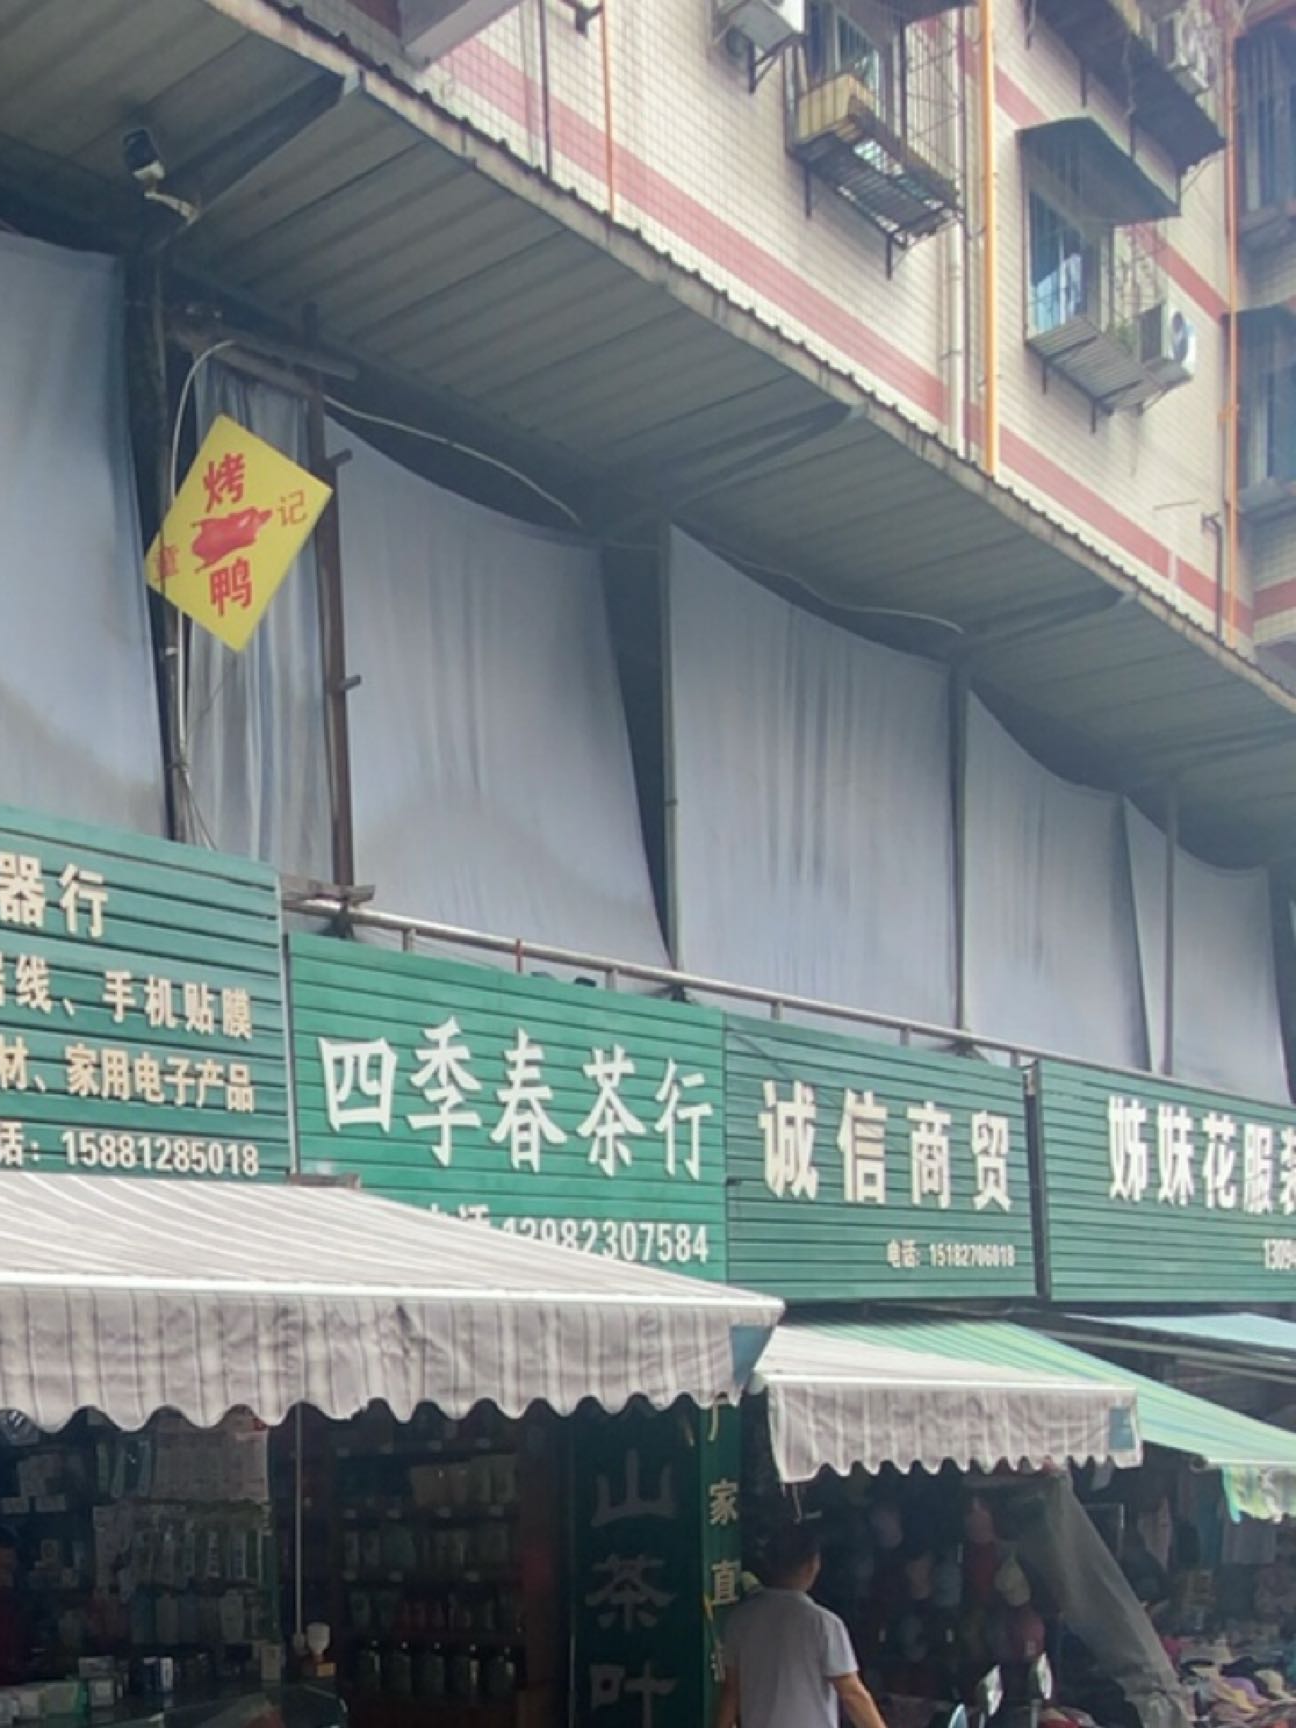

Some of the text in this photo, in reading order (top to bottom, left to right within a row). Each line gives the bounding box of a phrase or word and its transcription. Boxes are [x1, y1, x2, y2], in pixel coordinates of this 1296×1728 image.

[62, 1130, 259, 1177] 15881285018
[318, 1015, 715, 1181] 四季春茶行
[758, 1079, 1012, 1212] 诚信商贸
